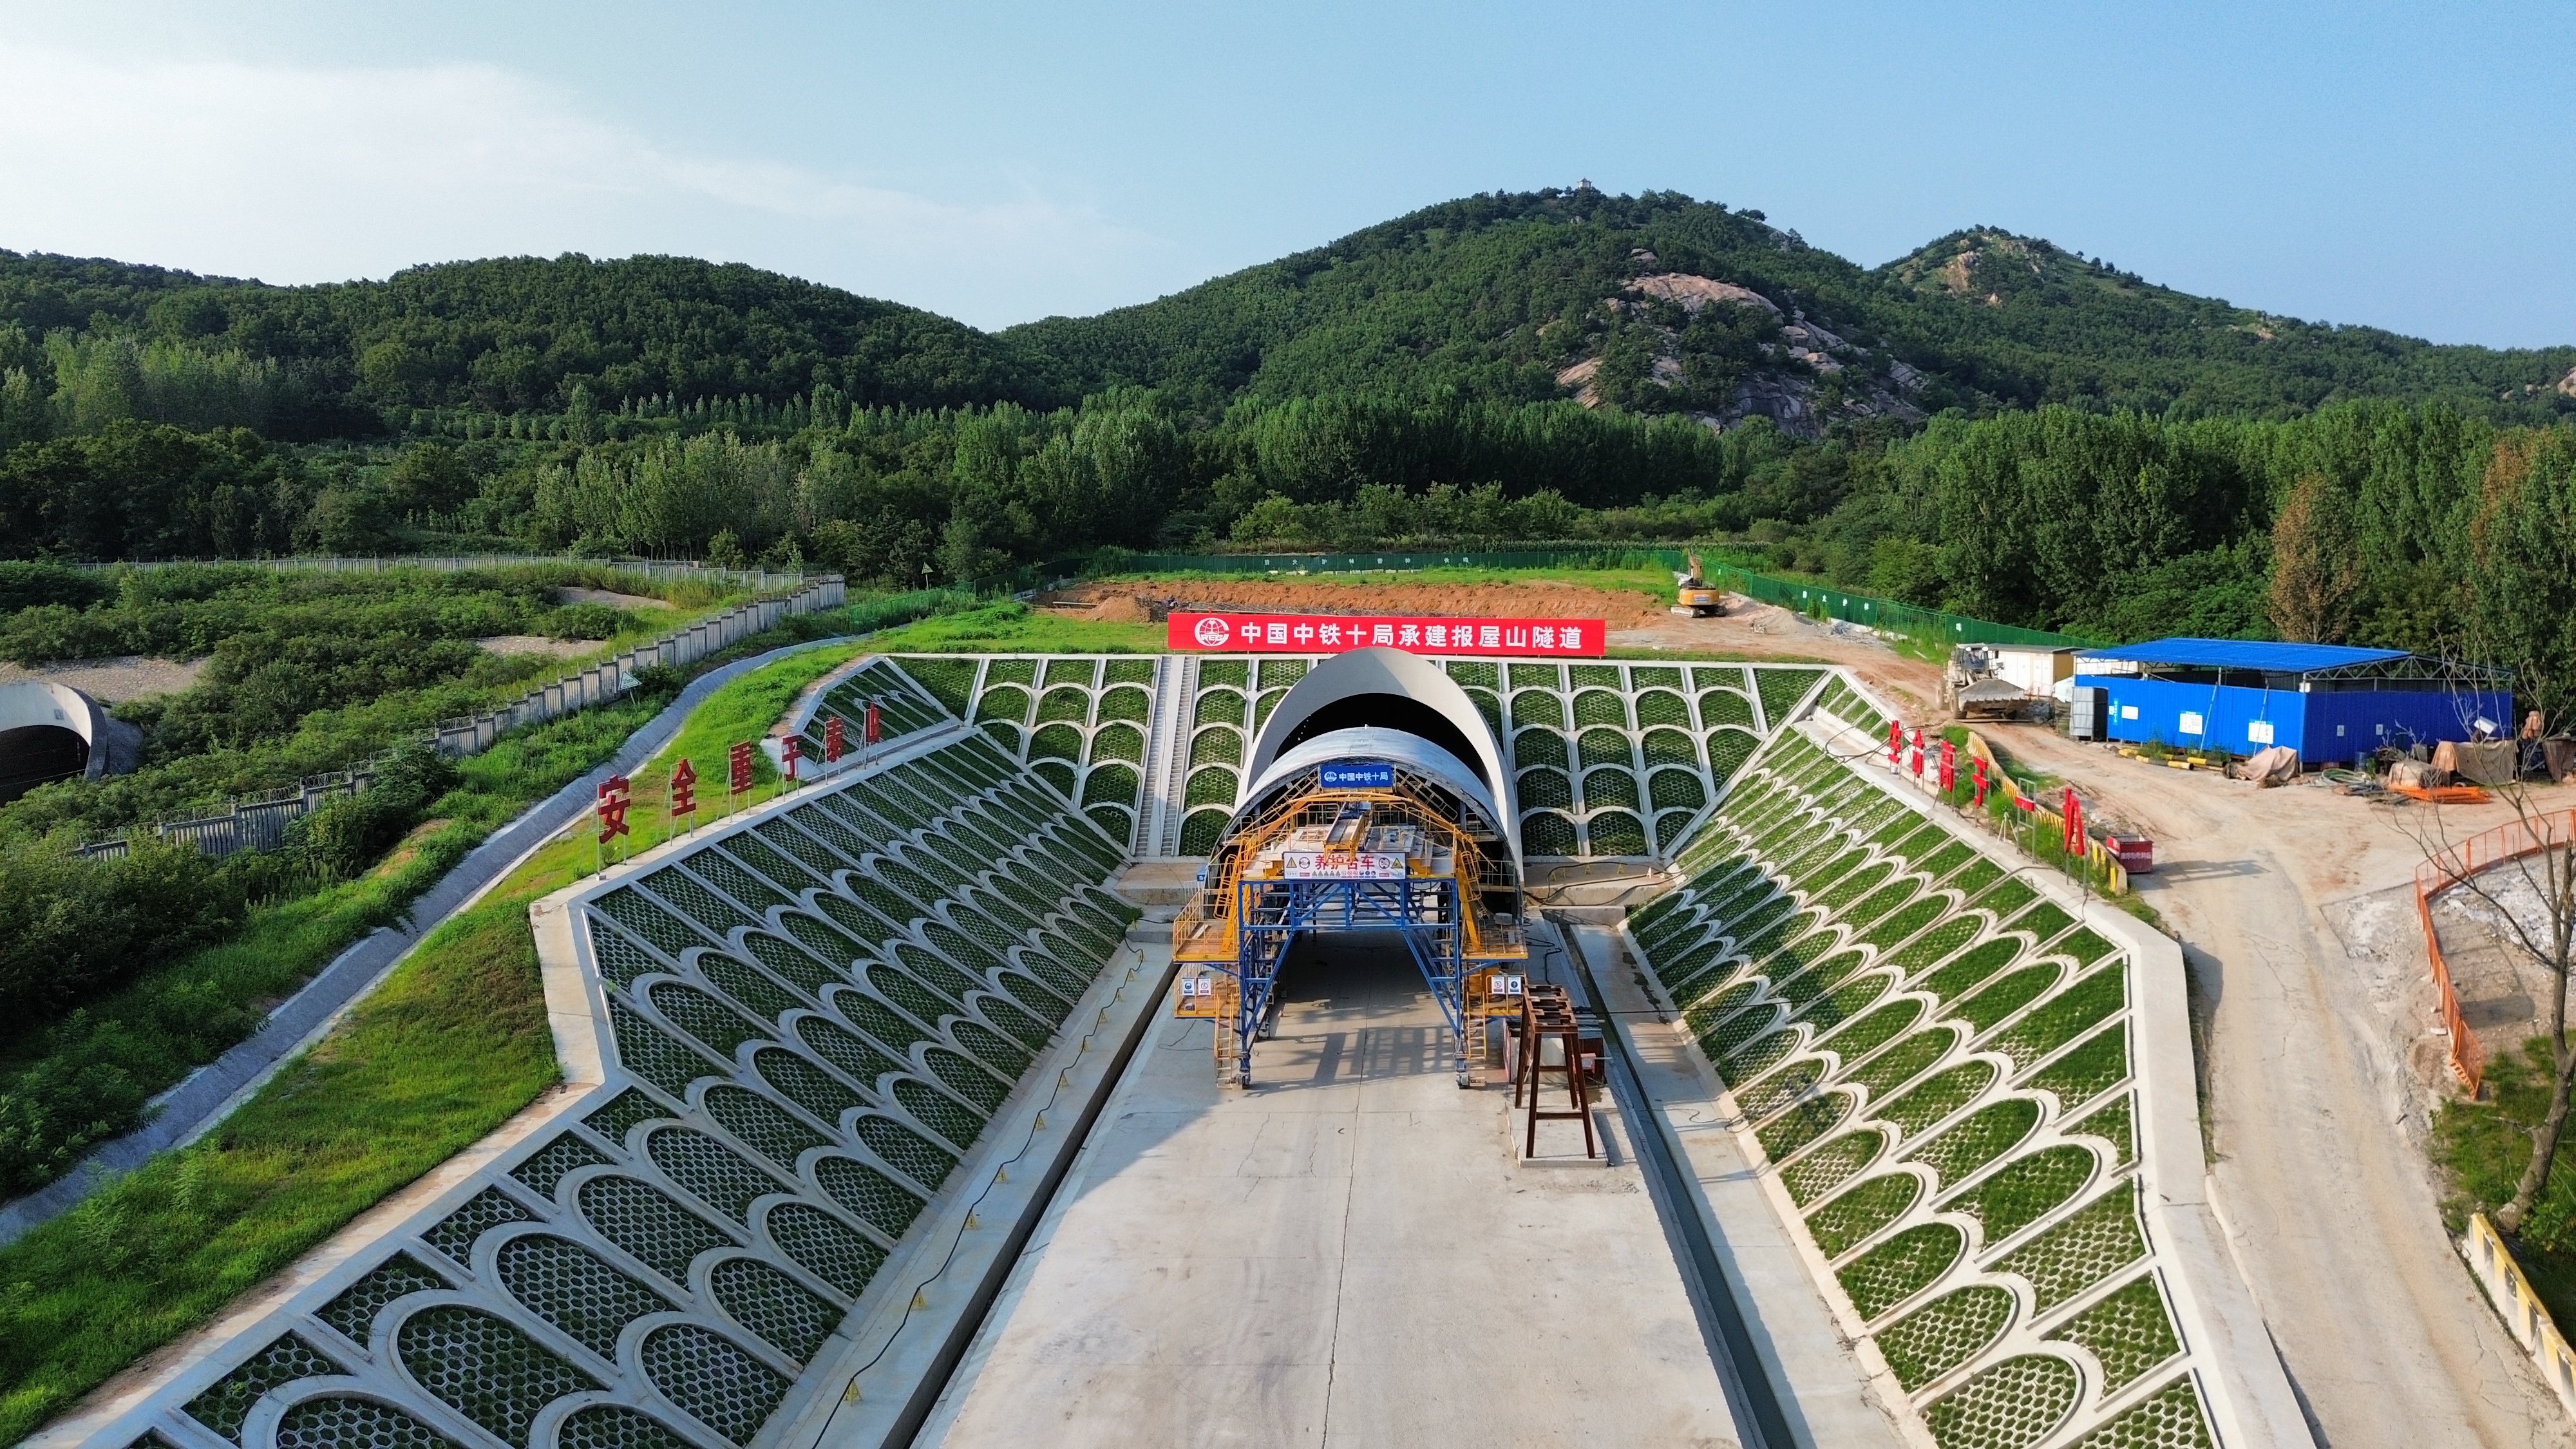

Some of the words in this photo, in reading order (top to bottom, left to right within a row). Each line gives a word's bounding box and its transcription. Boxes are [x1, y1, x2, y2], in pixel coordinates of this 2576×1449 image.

[1241, 621, 1582, 650] 中国中铁十局承建报屋山隧道
[1339, 772, 1388, 782] 中国中铁十局
[1314, 855, 1375, 870] 养护台车
